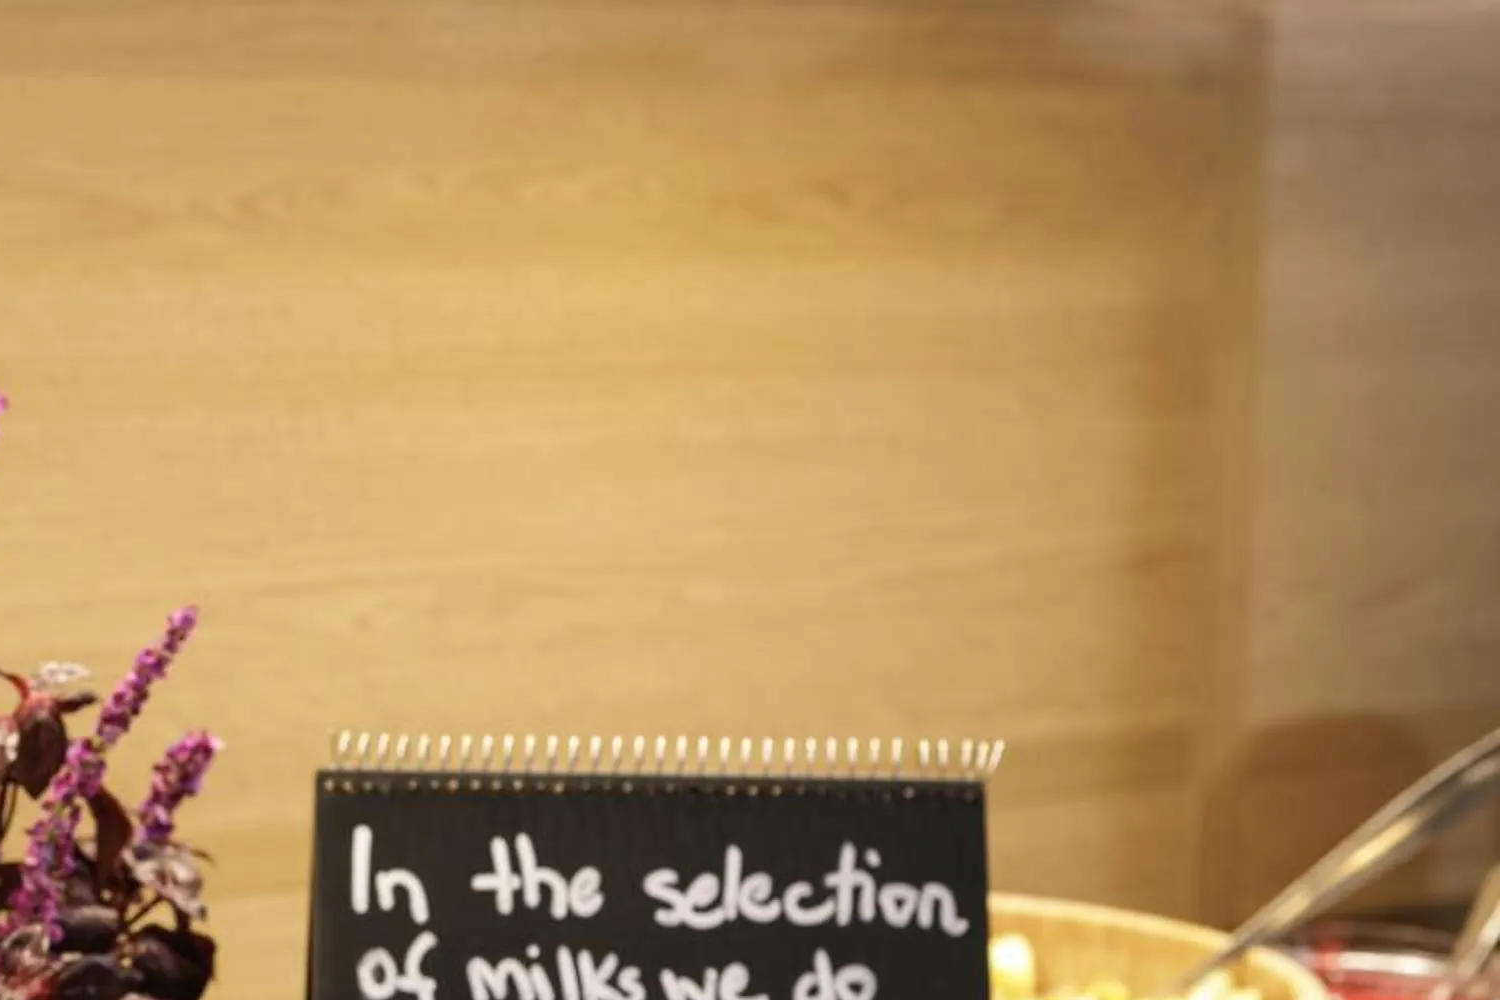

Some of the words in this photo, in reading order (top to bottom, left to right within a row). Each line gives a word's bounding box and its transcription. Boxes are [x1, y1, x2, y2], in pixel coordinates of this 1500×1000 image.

[350, 824, 430, 925] In
[470, 832, 605, 920] the
[642, 842, 970, 936] selection
